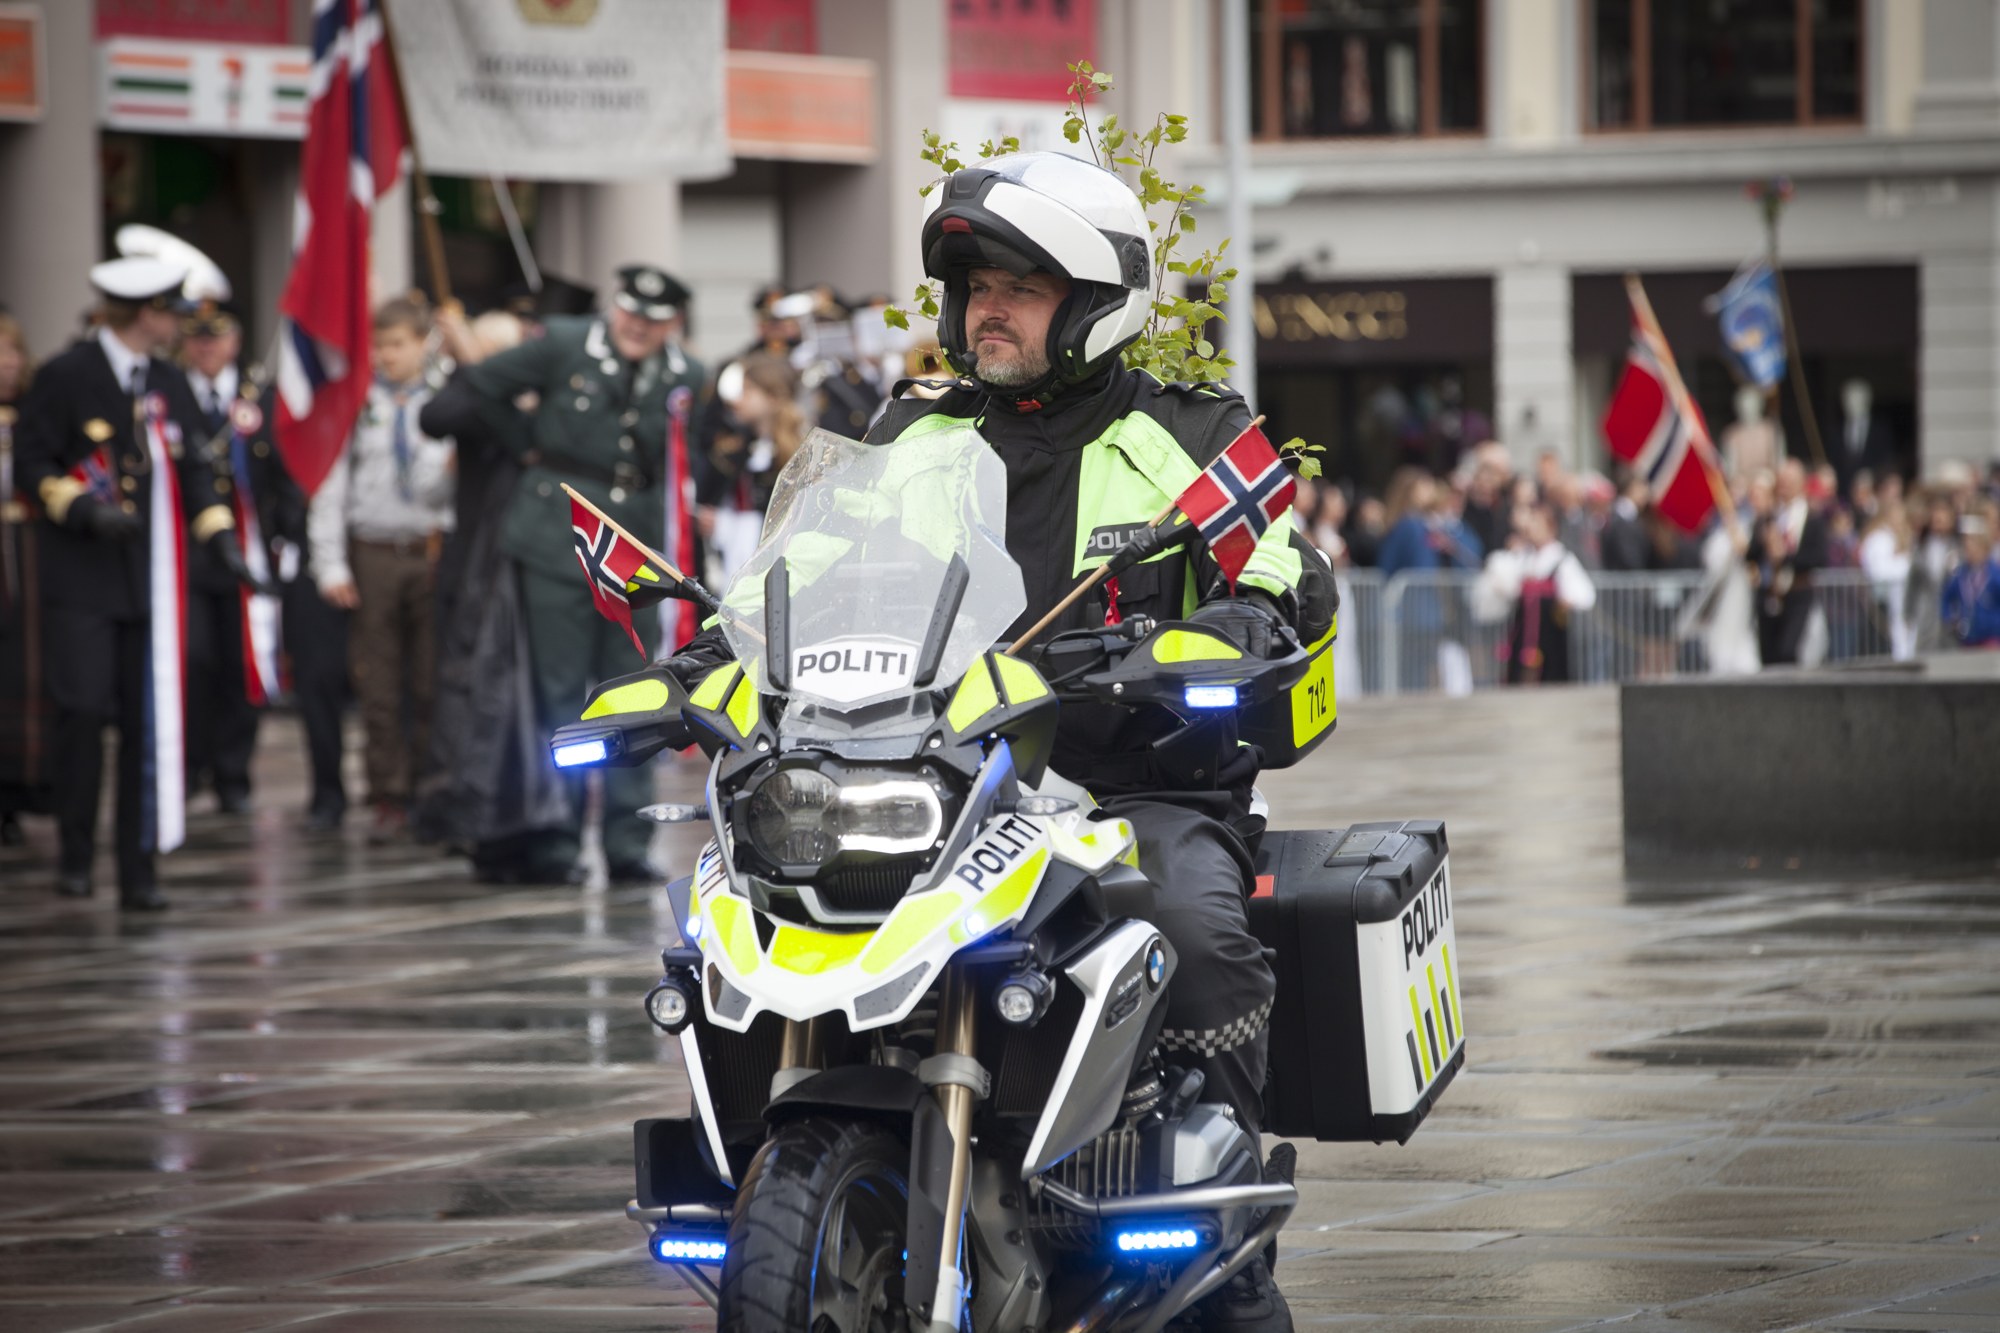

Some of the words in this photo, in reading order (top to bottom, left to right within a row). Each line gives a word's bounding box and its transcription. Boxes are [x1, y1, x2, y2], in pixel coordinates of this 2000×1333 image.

[797, 649, 908, 678] POLITI
[1307, 676, 1327, 724] 712
[954, 813, 1042, 893] POLITI
[1402, 864, 1449, 972] POLITI
